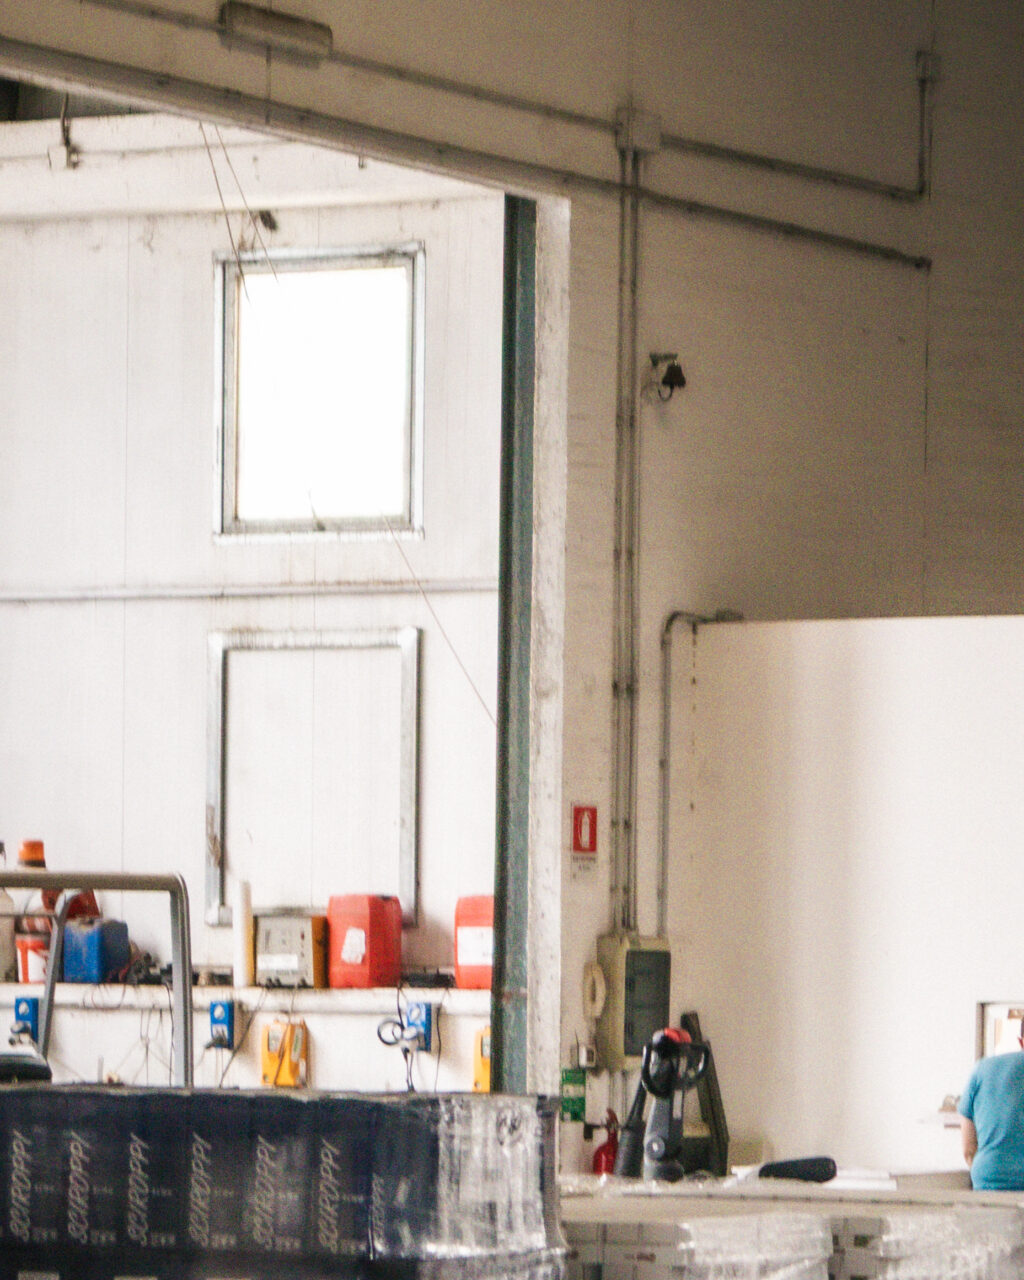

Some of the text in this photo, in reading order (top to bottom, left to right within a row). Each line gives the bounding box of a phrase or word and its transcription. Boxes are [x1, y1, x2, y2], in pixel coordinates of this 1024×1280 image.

[10, 1129, 32, 1242] SCIROPPI
[68, 1130, 91, 1244] SCIROPPI
[128, 1132, 150, 1247] SCIROPPI
[188, 1132, 212, 1248] SCIROPPI
[252, 1135, 276, 1251] SCIROPPI
[317, 1138, 341, 1254] SCIROPPI
